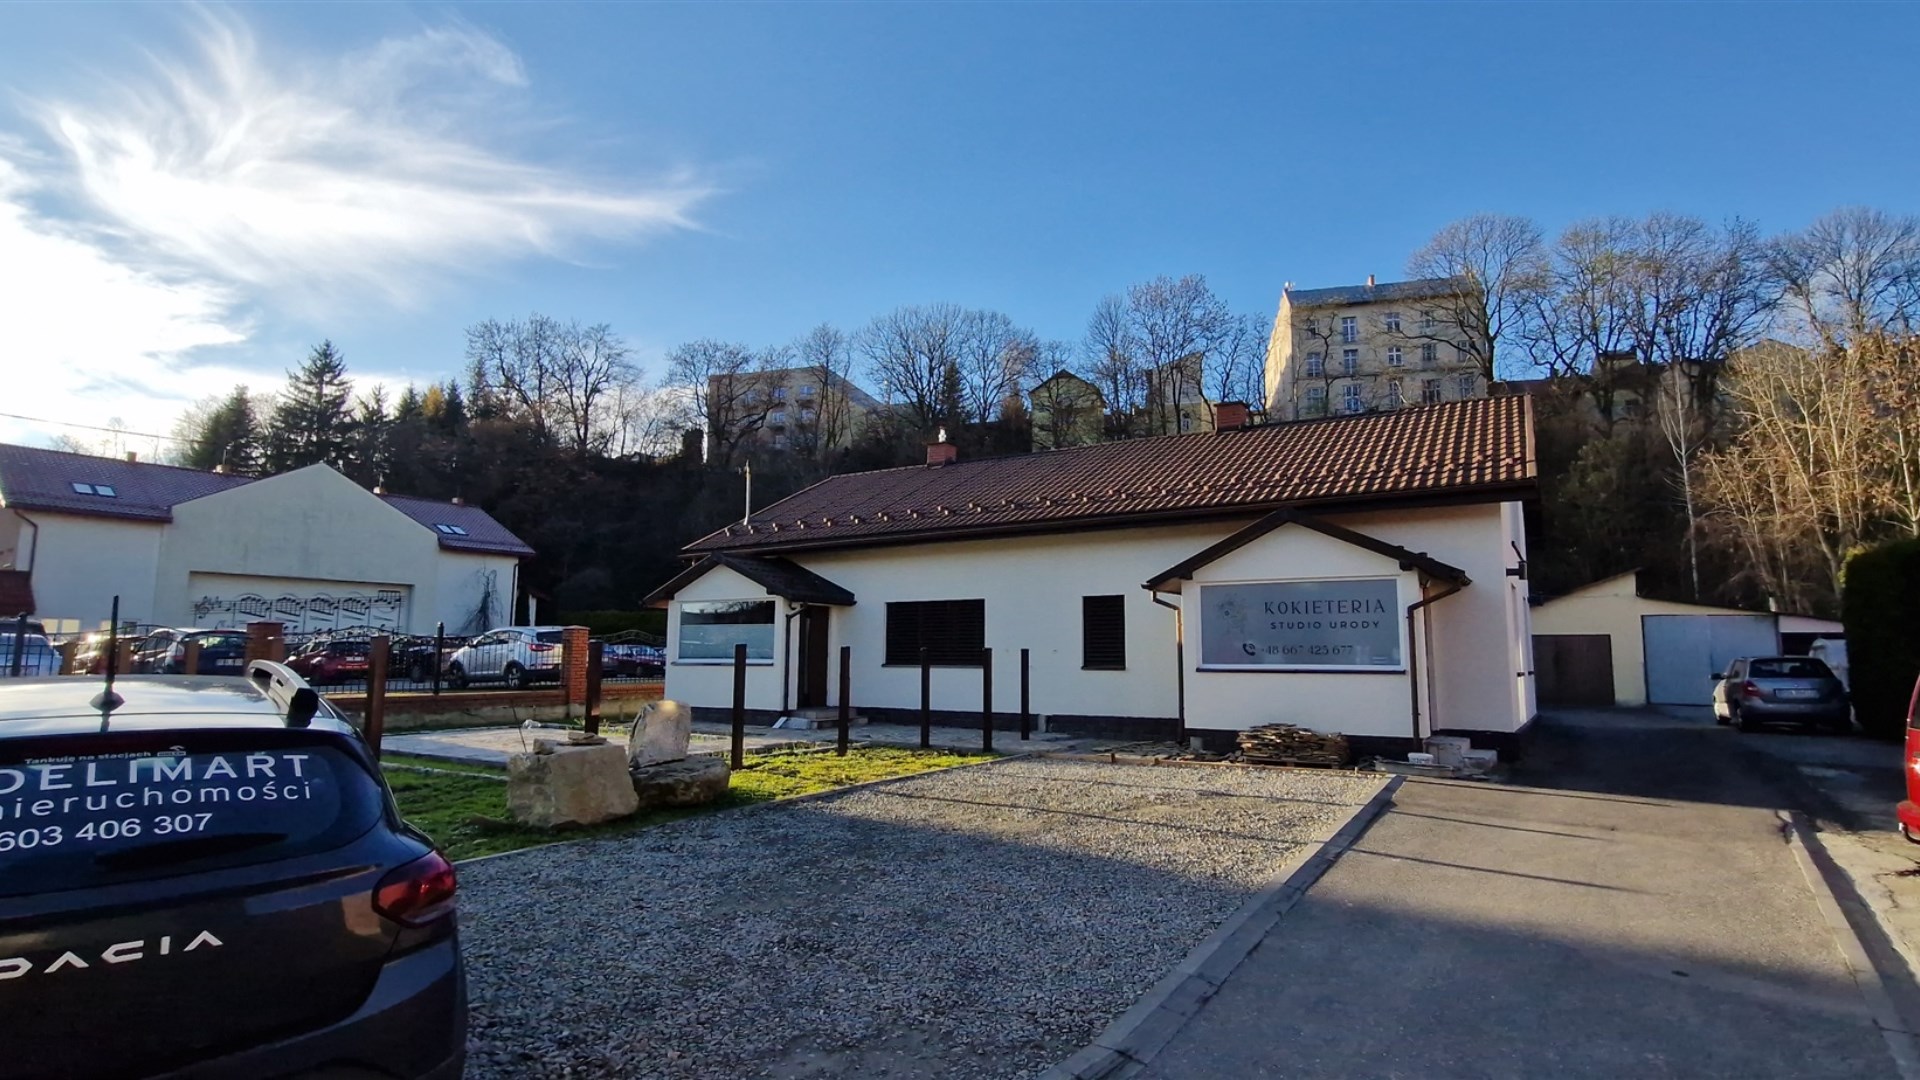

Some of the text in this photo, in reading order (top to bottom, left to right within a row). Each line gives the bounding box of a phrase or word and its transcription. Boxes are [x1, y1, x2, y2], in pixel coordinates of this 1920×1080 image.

[1264, 599, 1386, 615] KOKIETERIA
[1270, 620, 1380, 630] STUDIO URODY
[0, 755, 309, 795] DELIMART
[0, 781, 311, 820] ieruchomości
[0, 812, 213, 852] 603 406 307
[0, 930, 224, 981] DACIA
